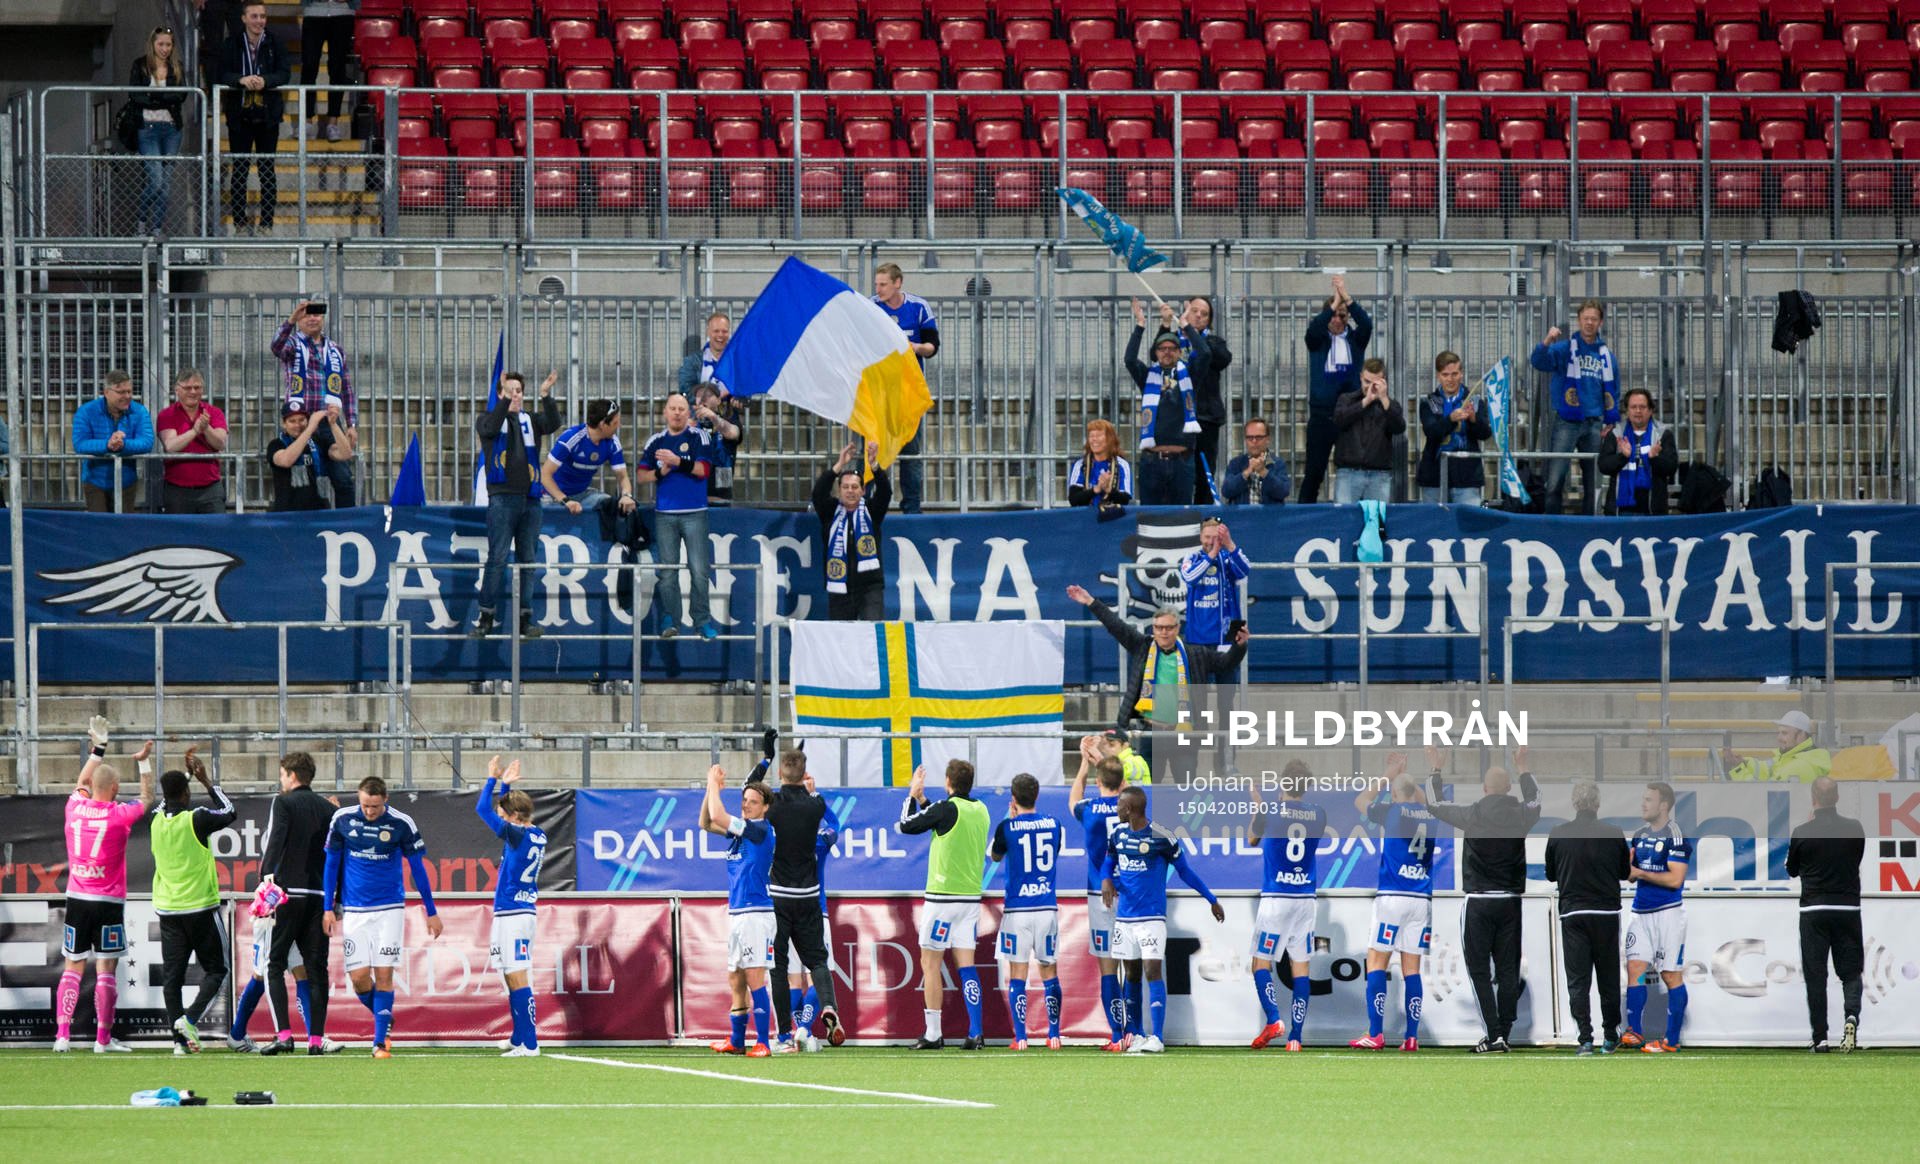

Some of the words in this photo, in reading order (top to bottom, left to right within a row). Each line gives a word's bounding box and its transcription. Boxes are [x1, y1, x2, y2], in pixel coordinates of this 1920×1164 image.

[316, 530, 1042, 631] PATRONENA
[1291, 529, 1903, 633] SUNDSVALL
[70, 818, 108, 858] 17
[593, 828, 734, 860] DAHL
[1009, 816, 1057, 832] LUNDSTRÖM
[1286, 822, 1307, 862] 8
[1408, 822, 1427, 860] 4
[1018, 830, 1054, 873] 15
